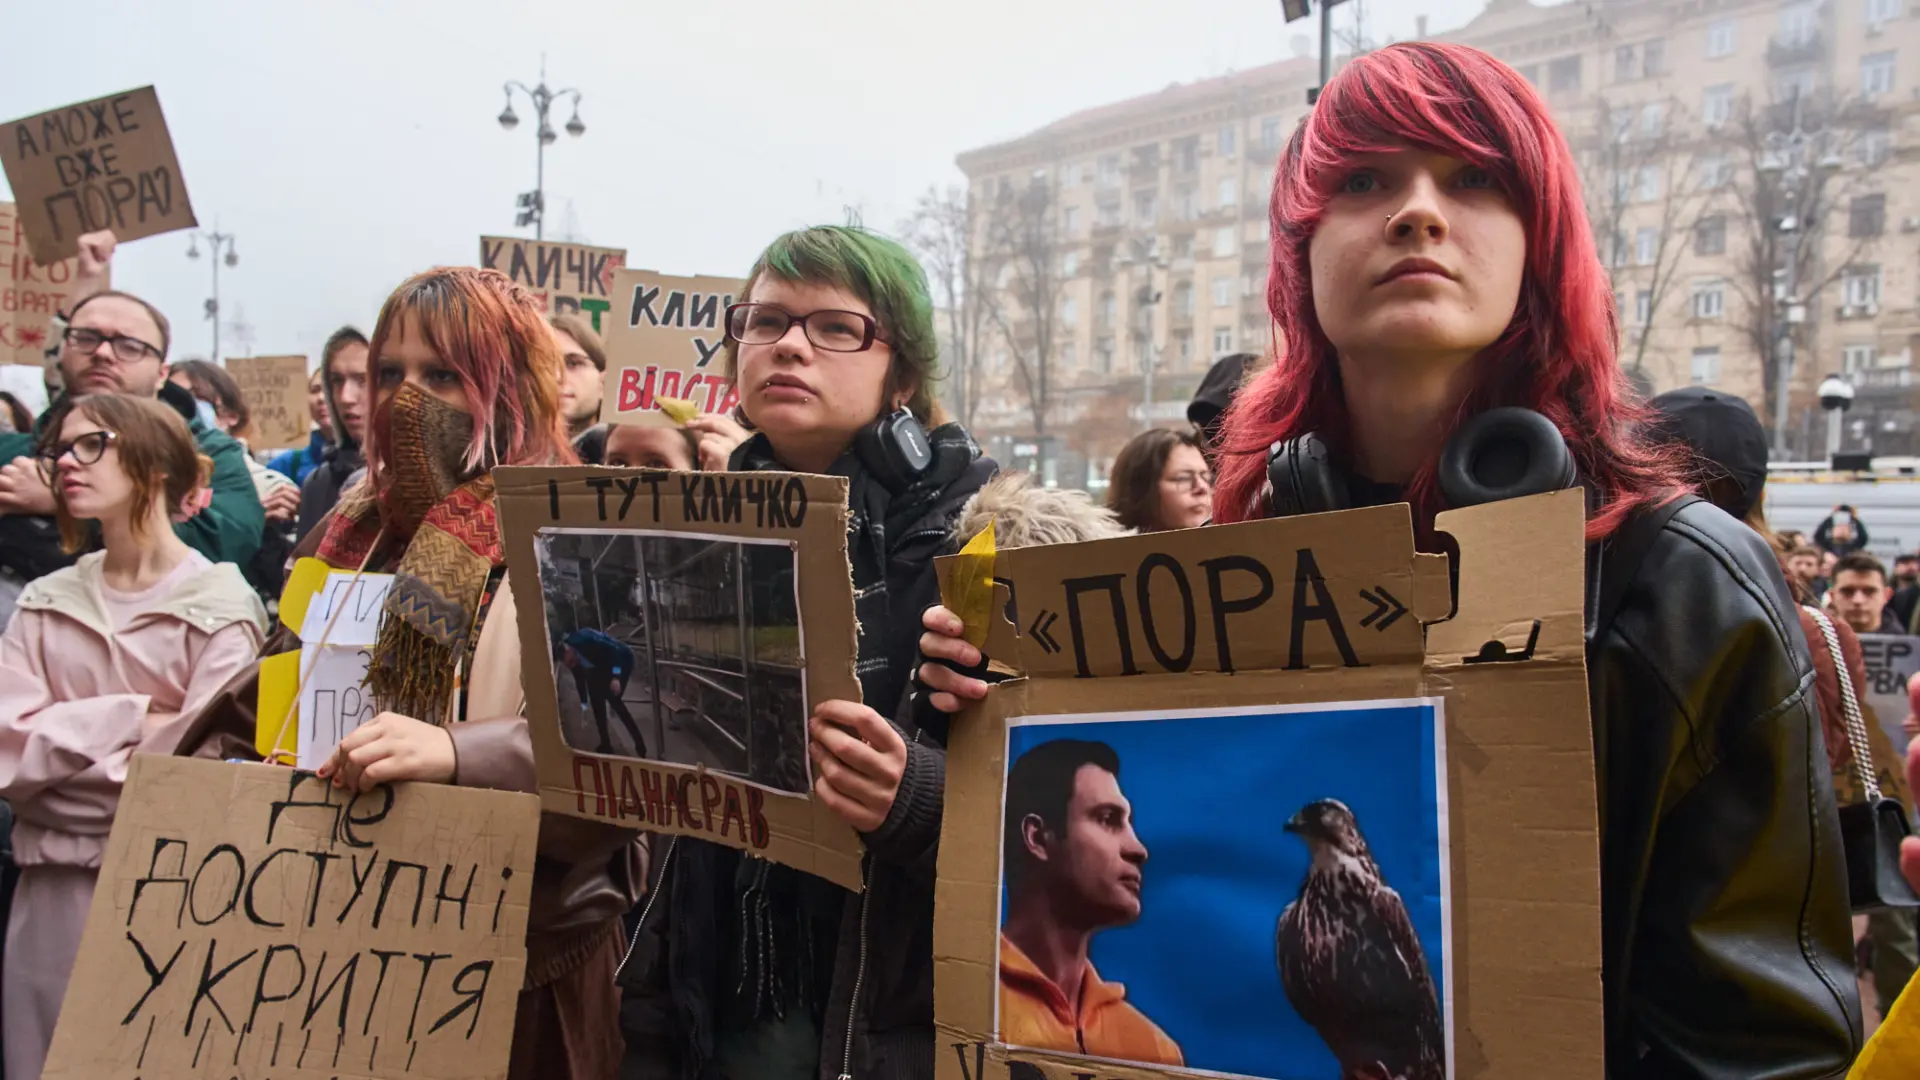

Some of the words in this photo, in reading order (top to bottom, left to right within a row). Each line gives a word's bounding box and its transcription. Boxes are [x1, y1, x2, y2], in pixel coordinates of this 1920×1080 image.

[15, 123, 39, 160] А
[40, 95, 140, 152] МОЖЕ
[54, 143, 121, 189] ВЖЕ
[43, 165, 172, 242] ПОРА?
[630, 285, 733, 328] КЛИ
[586, 472, 669, 523] ТУТ
[680, 474, 808, 531] КЛИЧКО
[1027, 546, 1410, 679] «ПОРА»
[573, 756, 770, 850] ПІДНАСРАВ
[121, 930, 494, 1044] УКРИТТЯ
